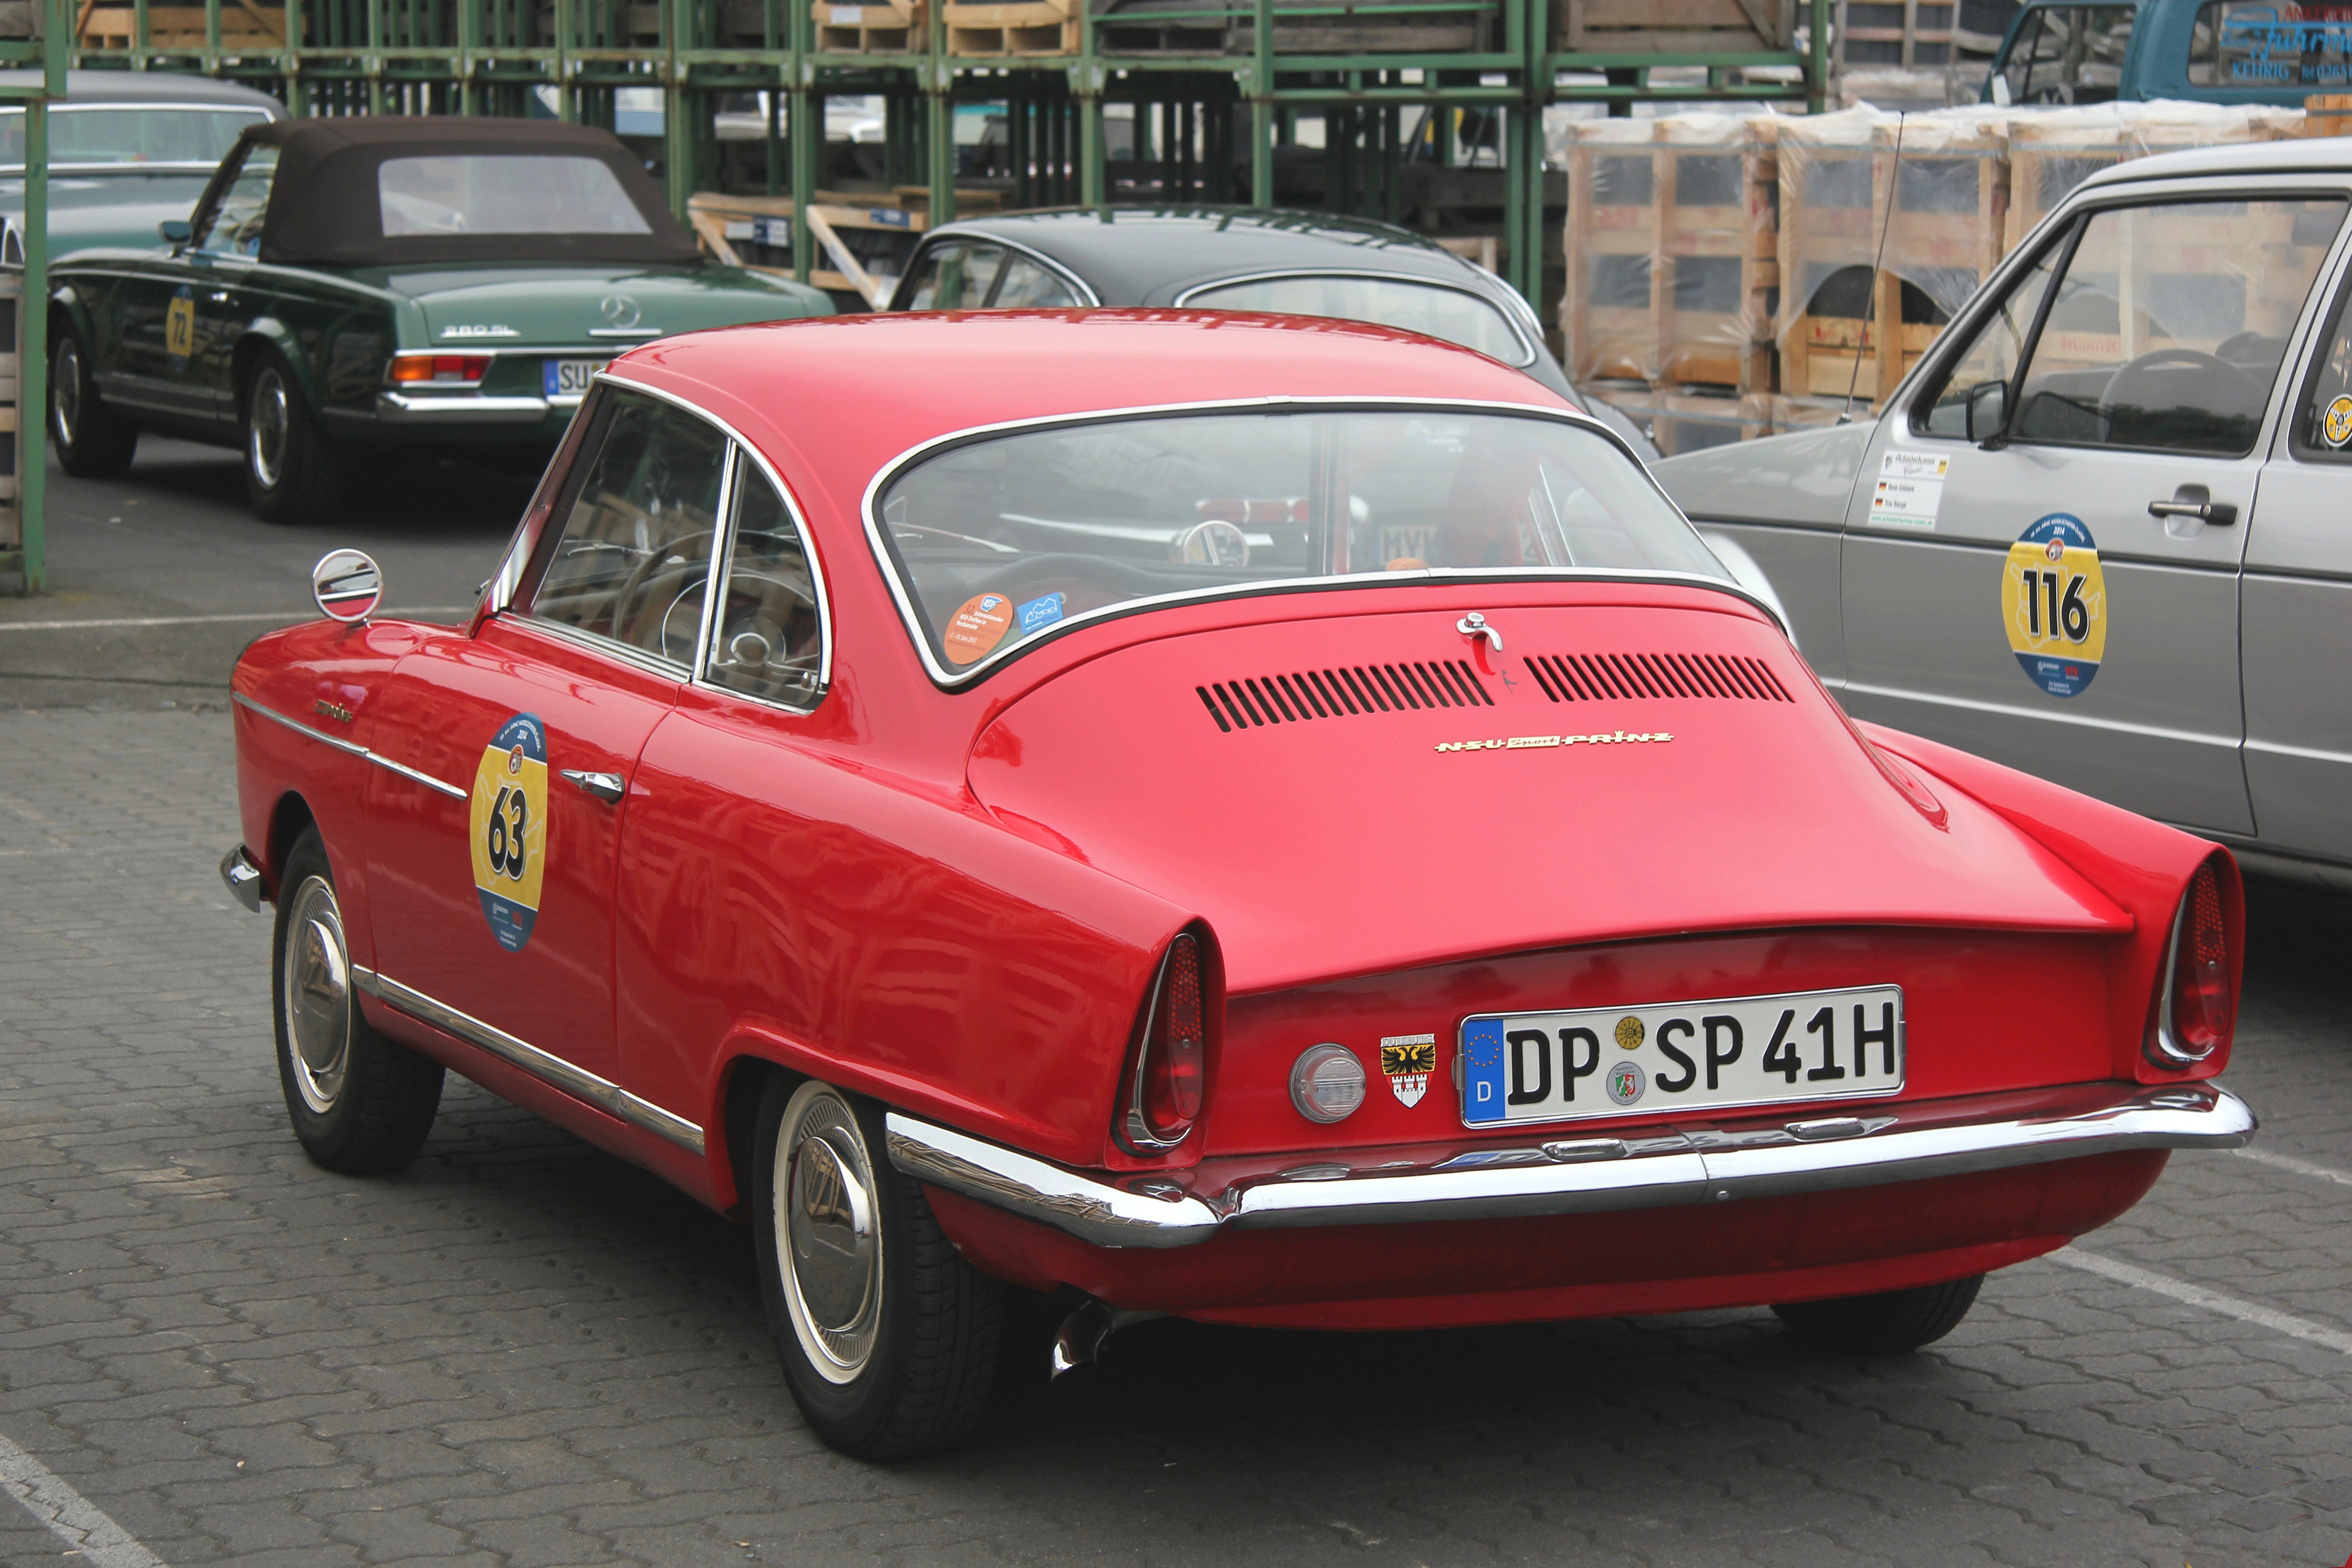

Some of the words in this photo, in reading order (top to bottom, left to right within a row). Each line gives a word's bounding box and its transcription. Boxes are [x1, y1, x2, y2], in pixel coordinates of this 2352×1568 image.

[2232, 60, 2289, 80] KEHRIG
[560, 365, 588, 390] SU
[2053, 526, 2065, 536] 2014
[964, 604, 975, 615] 32.
[974, 610, 1004, 623] Internationales
[982, 598, 996, 609] NSU
[2022, 569, 2090, 644] 116
[956, 620, 978, 630] Neckarsulm
[1436, 739, 1504, 753] NSU
[1509, 737, 1558, 747] Sport
[1562, 731, 1673, 745] PRINZ
[488, 784, 527, 881] 63
[1383, 1035, 1433, 1046] DUISBURG
[1506, 1027, 1599, 1105] DP
[1655, 1015, 1743, 1093] SP
[1763, 1002, 1894, 1084] 41H
[1476, 1080, 1492, 1102] D
